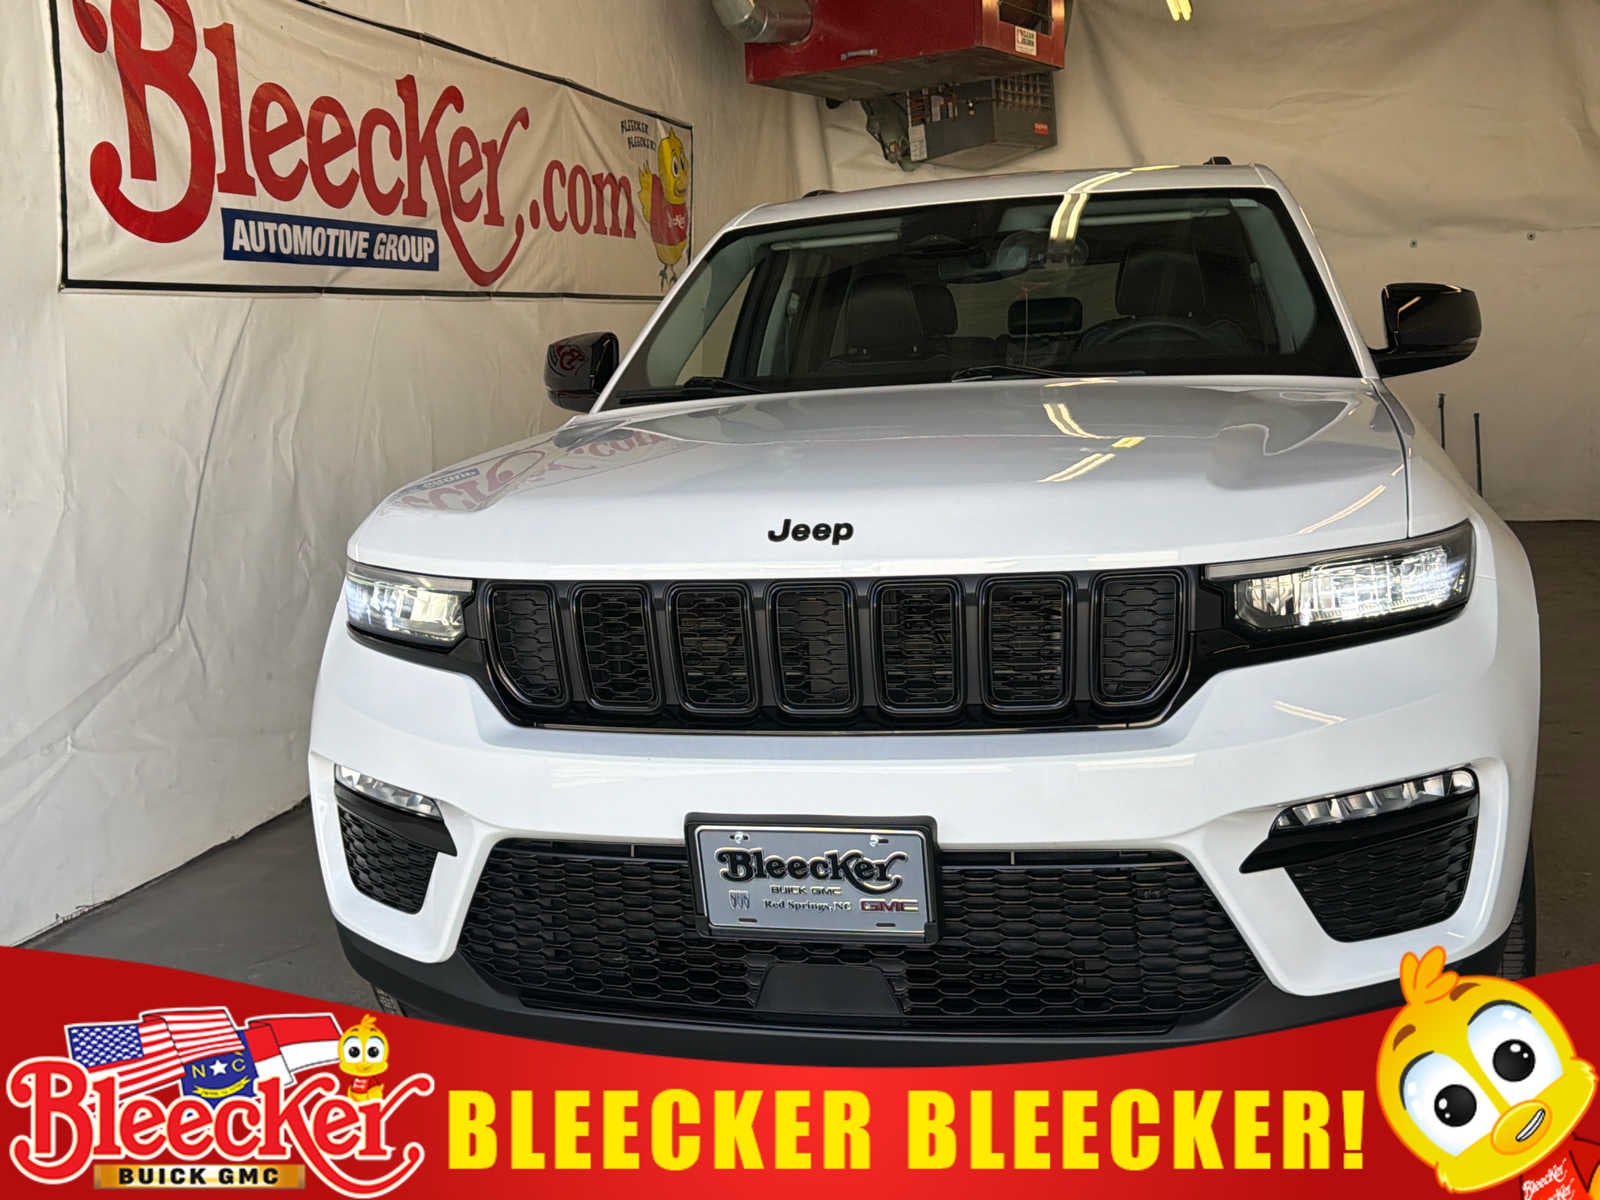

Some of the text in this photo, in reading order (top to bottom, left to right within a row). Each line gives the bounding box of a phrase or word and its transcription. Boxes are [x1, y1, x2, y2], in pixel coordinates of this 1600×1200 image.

[232, 219, 435, 263] AUTOMOTIVE GROUP
[767, 519, 854, 545] Jeep
[716, 848, 909, 895] Bleecker
[770, 886, 842, 896] BUICK GMC
[764, 899, 785, 909] Red
[834, 902, 851, 911] NC
[860, 899, 919, 912] GMC
